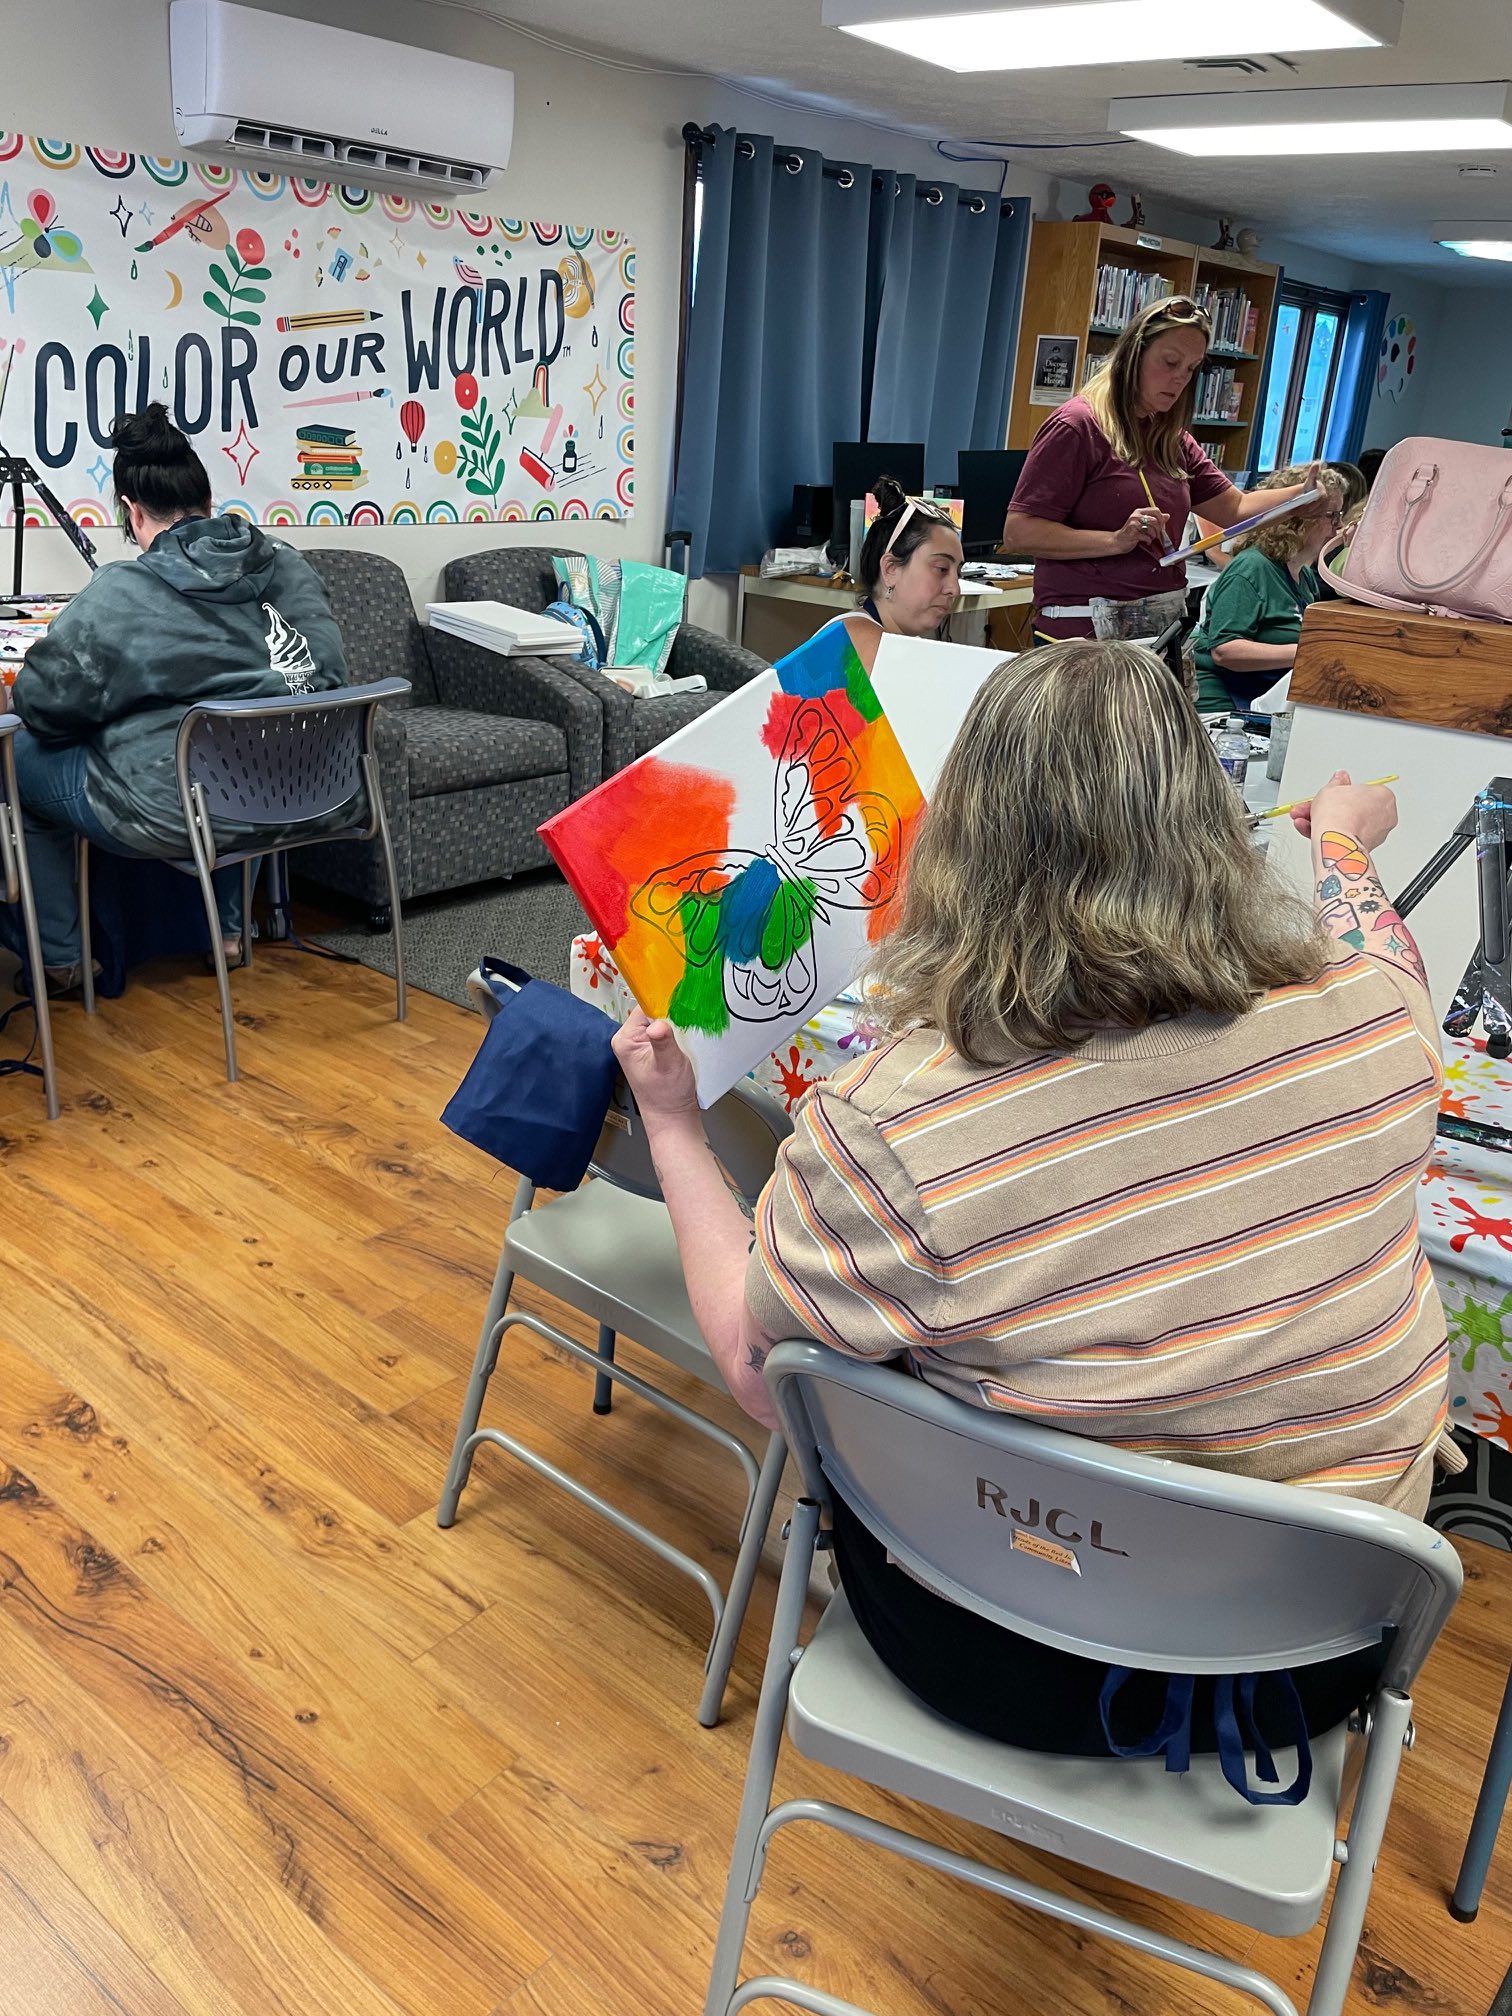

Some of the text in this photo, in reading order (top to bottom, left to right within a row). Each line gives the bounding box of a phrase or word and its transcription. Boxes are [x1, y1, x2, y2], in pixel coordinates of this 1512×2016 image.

[34, 326, 259, 469] COLOR
[278, 332, 386, 392] OUR
[401, 269, 565, 394] WORLD
[976, 1476, 1132, 1558] RJCL
